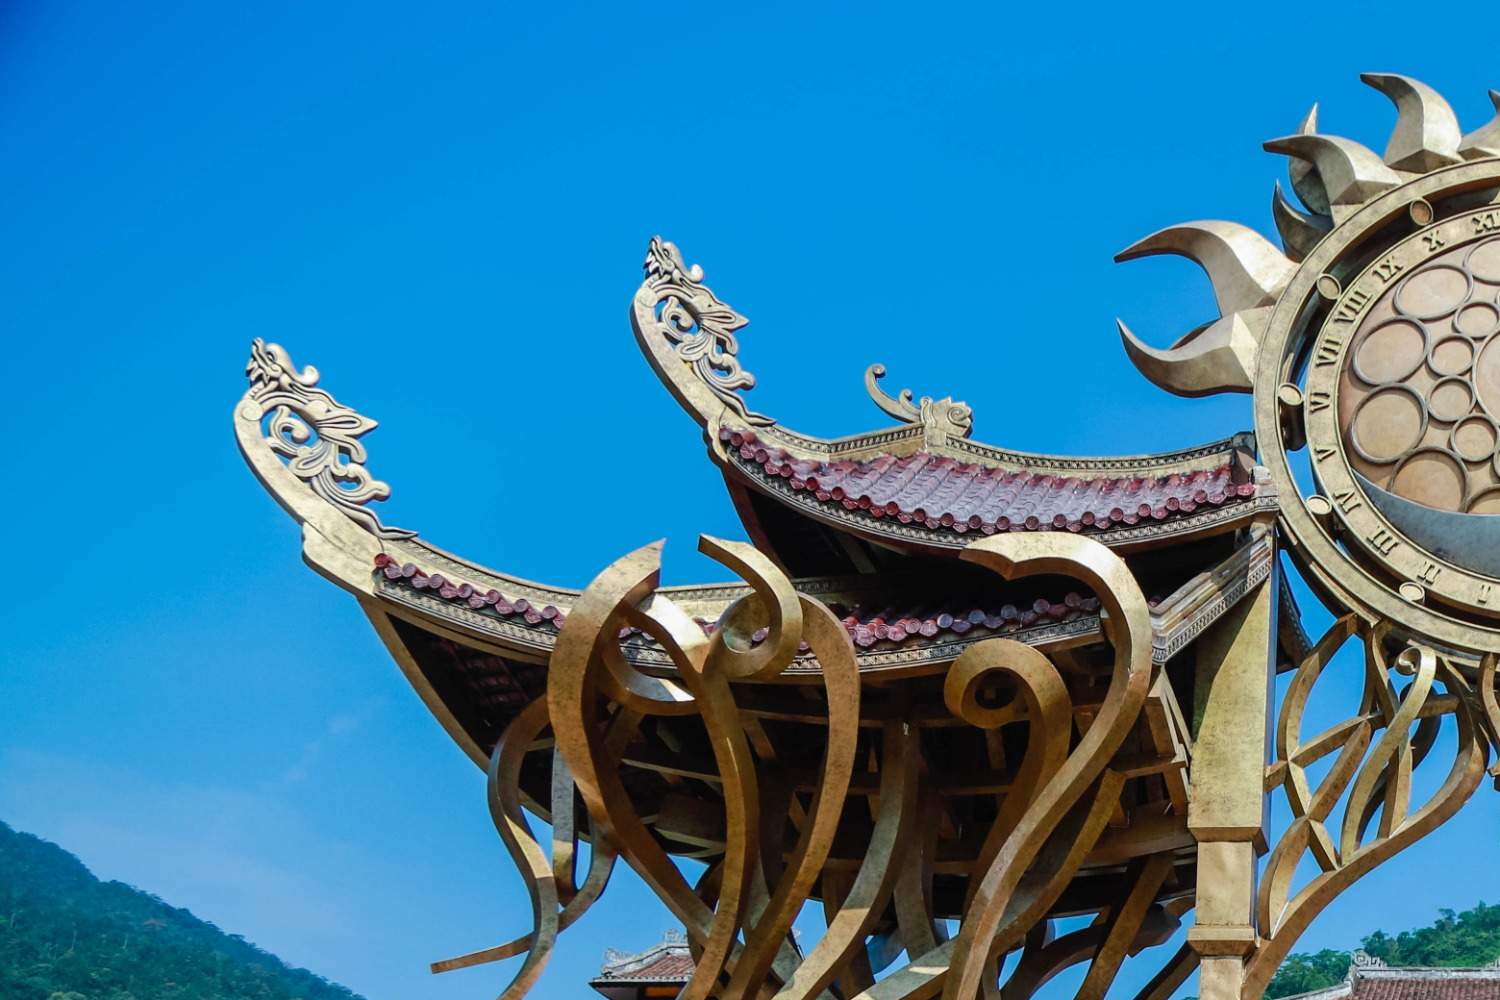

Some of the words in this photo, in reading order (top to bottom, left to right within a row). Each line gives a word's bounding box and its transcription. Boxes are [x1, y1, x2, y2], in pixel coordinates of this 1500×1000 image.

[1422, 229, 1446, 252] X
[1372, 255, 1404, 285] IX
[1334, 287, 1373, 325] VIII
[1315, 338, 1344, 369] VII
